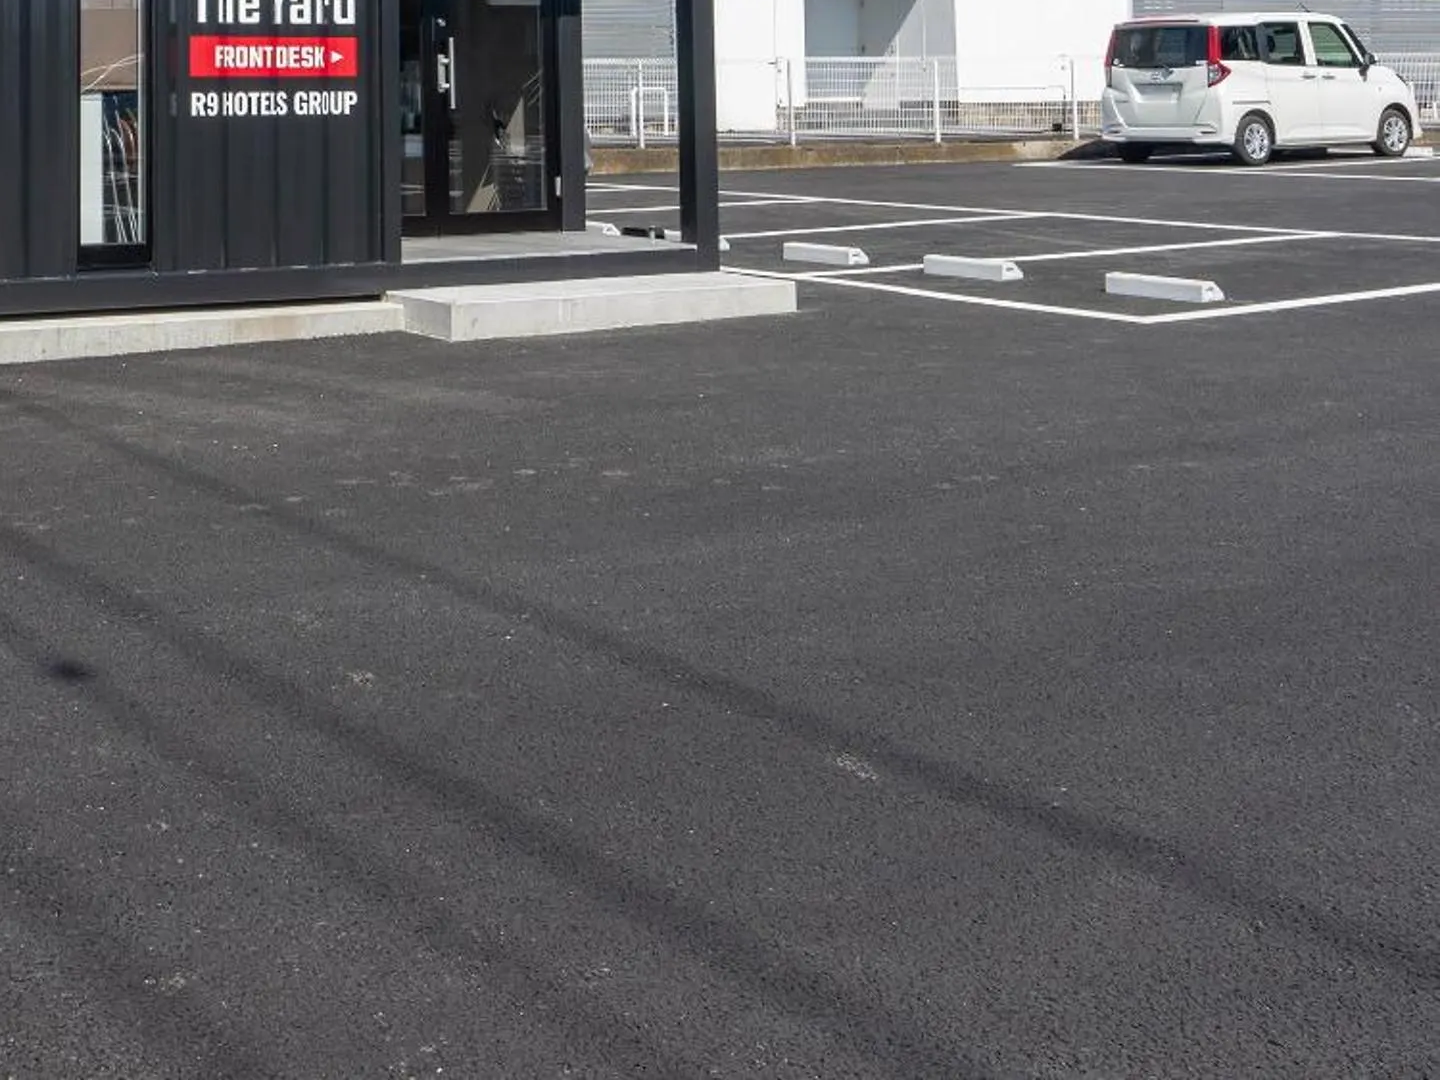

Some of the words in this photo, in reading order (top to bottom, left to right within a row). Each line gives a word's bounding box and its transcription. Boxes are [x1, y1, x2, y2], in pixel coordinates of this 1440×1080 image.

[191, 92, 219, 117] R9
[222, 91, 288, 117] HOTELS
[293, 91, 358, 115] GROUP
